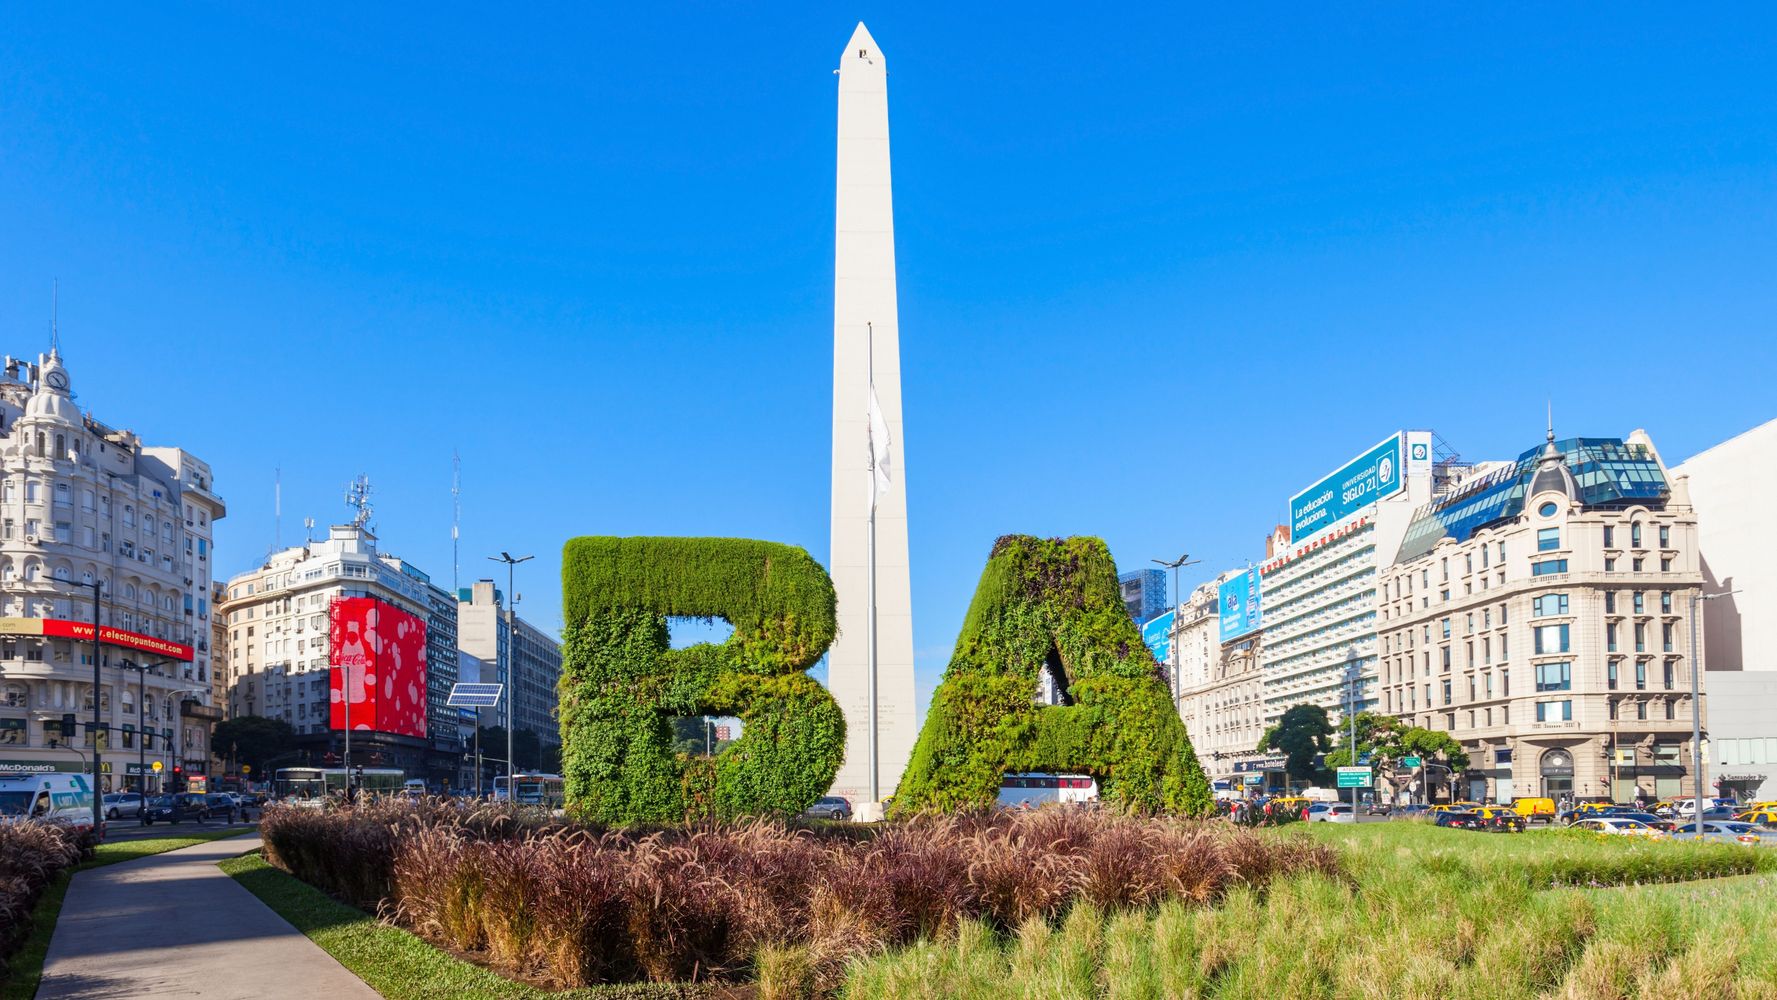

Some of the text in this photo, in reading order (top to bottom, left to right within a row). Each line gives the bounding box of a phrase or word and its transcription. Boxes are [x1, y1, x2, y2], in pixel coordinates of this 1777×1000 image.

[1342, 465, 1377, 490] UNIVERSIDAD
[1342, 475, 1377, 505] SIGLO 21
[1295, 490, 1333, 519] La educación
[1295, 507, 1328, 531] evoluciona.
[1260, 555, 1291, 575] HOTEL
[0, 764, 55, 772] McDonald's
